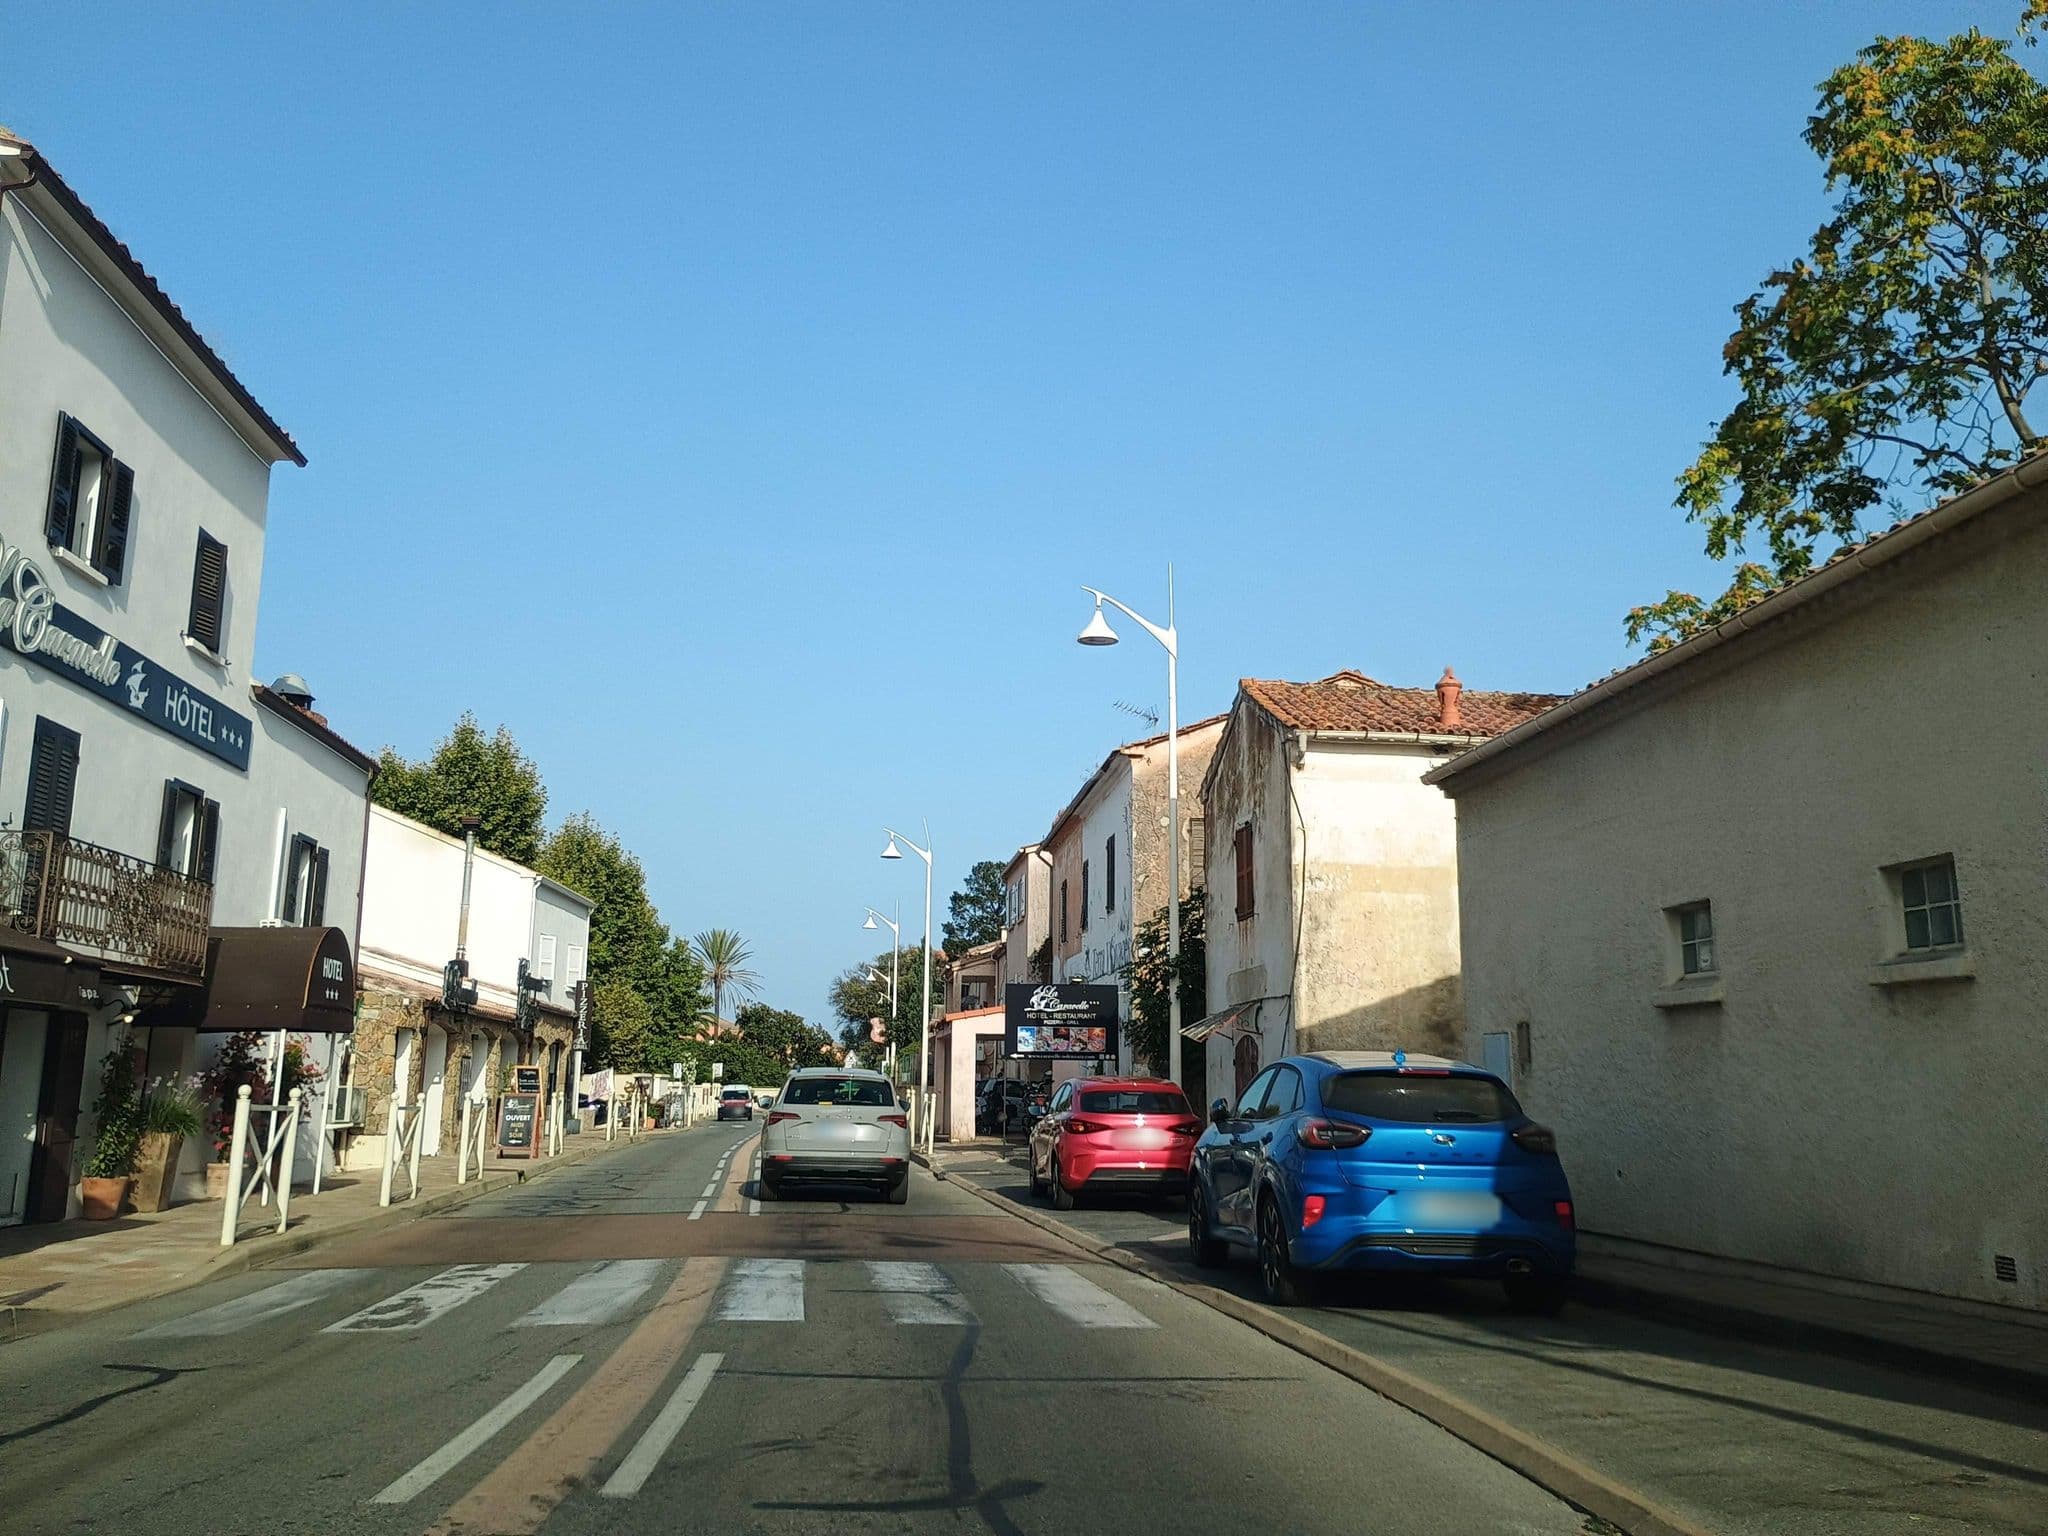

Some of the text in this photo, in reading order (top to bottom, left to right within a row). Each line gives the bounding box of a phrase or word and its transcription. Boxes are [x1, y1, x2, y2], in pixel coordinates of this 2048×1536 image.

[164, 686, 216, 743] HÔTEL
[322, 956, 343, 981] HOTEL
[578, 982, 588, 1044] PIZZERIA
[1048, 997, 1090, 1010] Caravelle
[1053, 1012, 1097, 1020] RESTAURANT
